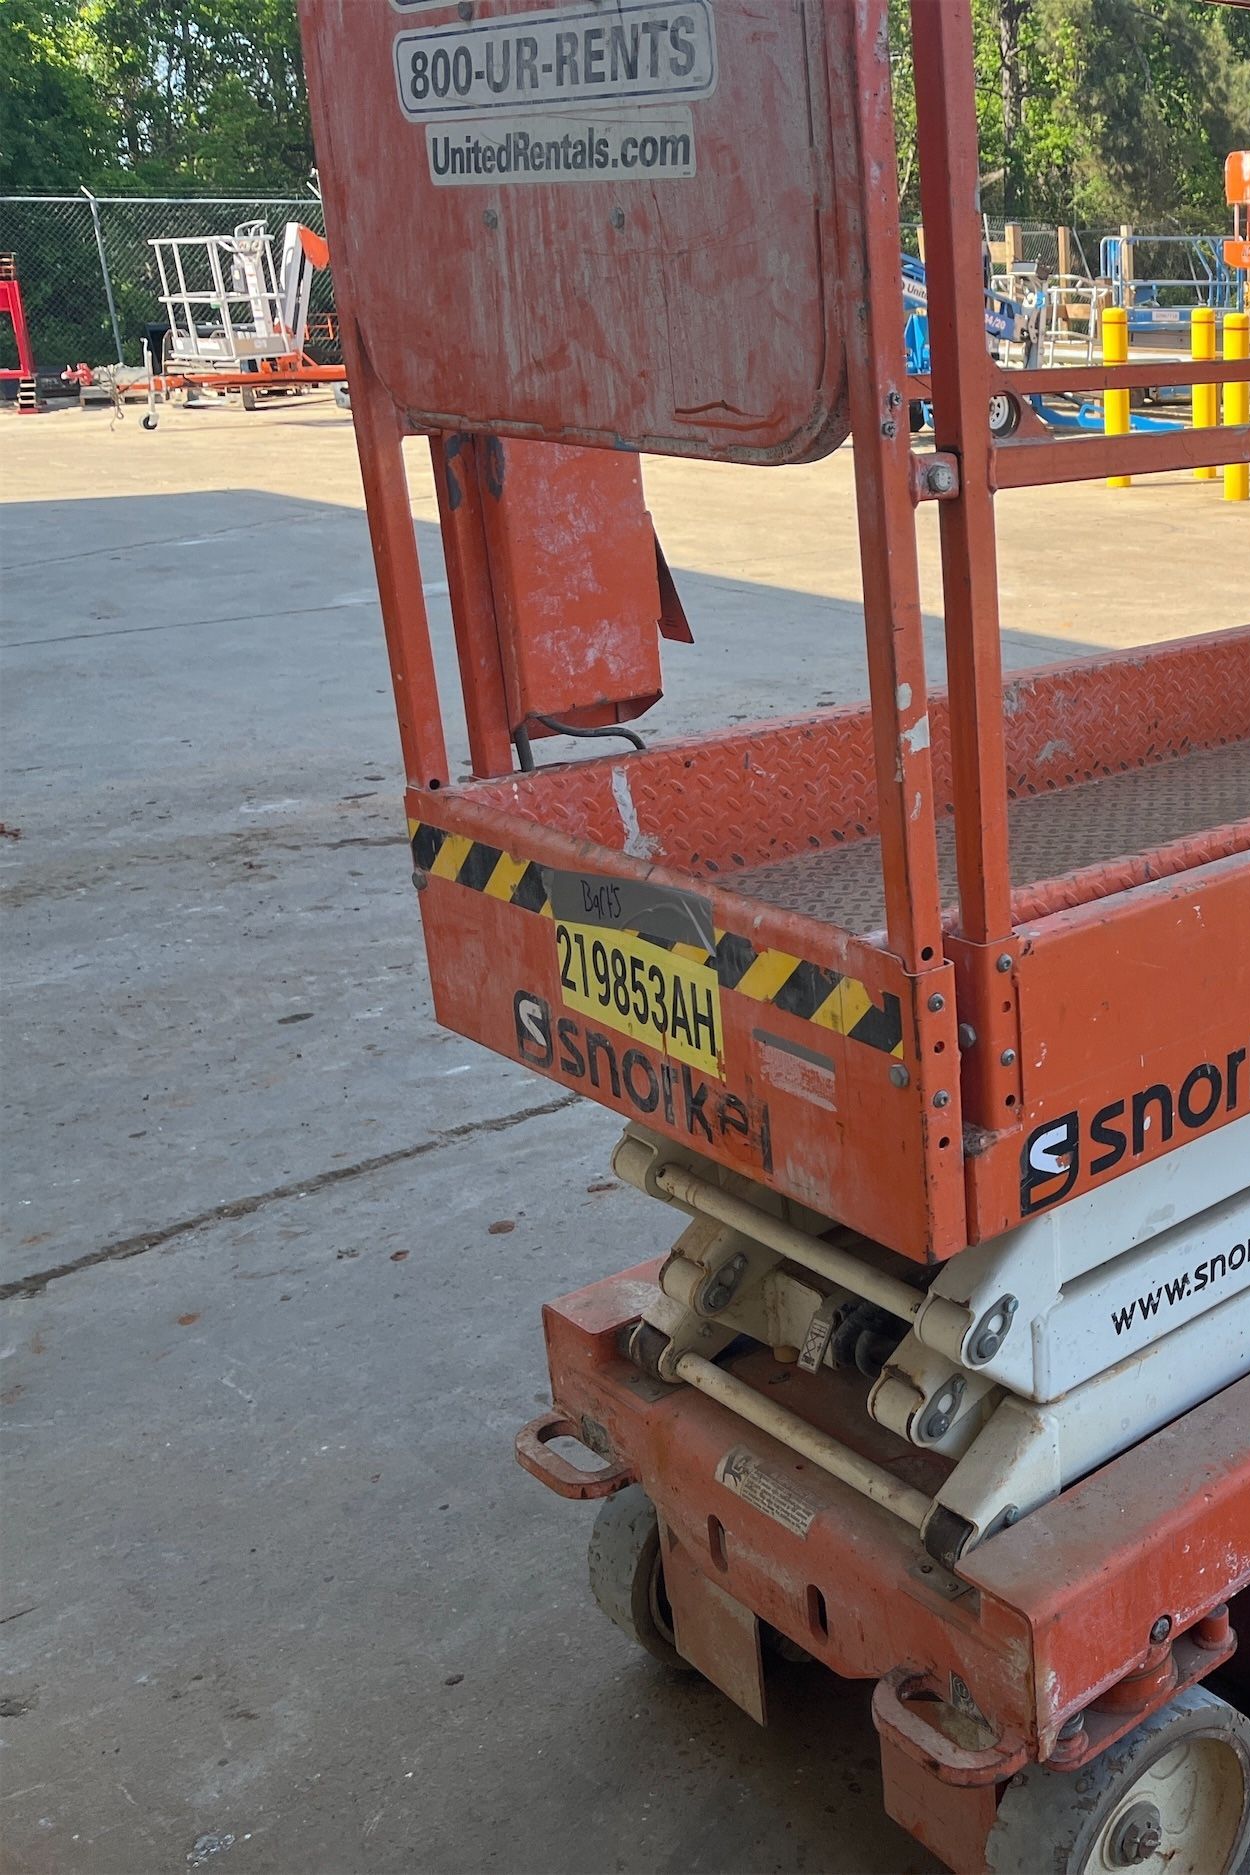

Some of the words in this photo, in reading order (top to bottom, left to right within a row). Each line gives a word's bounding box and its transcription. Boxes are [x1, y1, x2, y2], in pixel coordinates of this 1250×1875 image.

[410, 15, 696, 99] 800-UR-RENTS
[432, 127, 690, 176] UnitedRentals.com
[557, 924, 716, 1057] 219853AH
